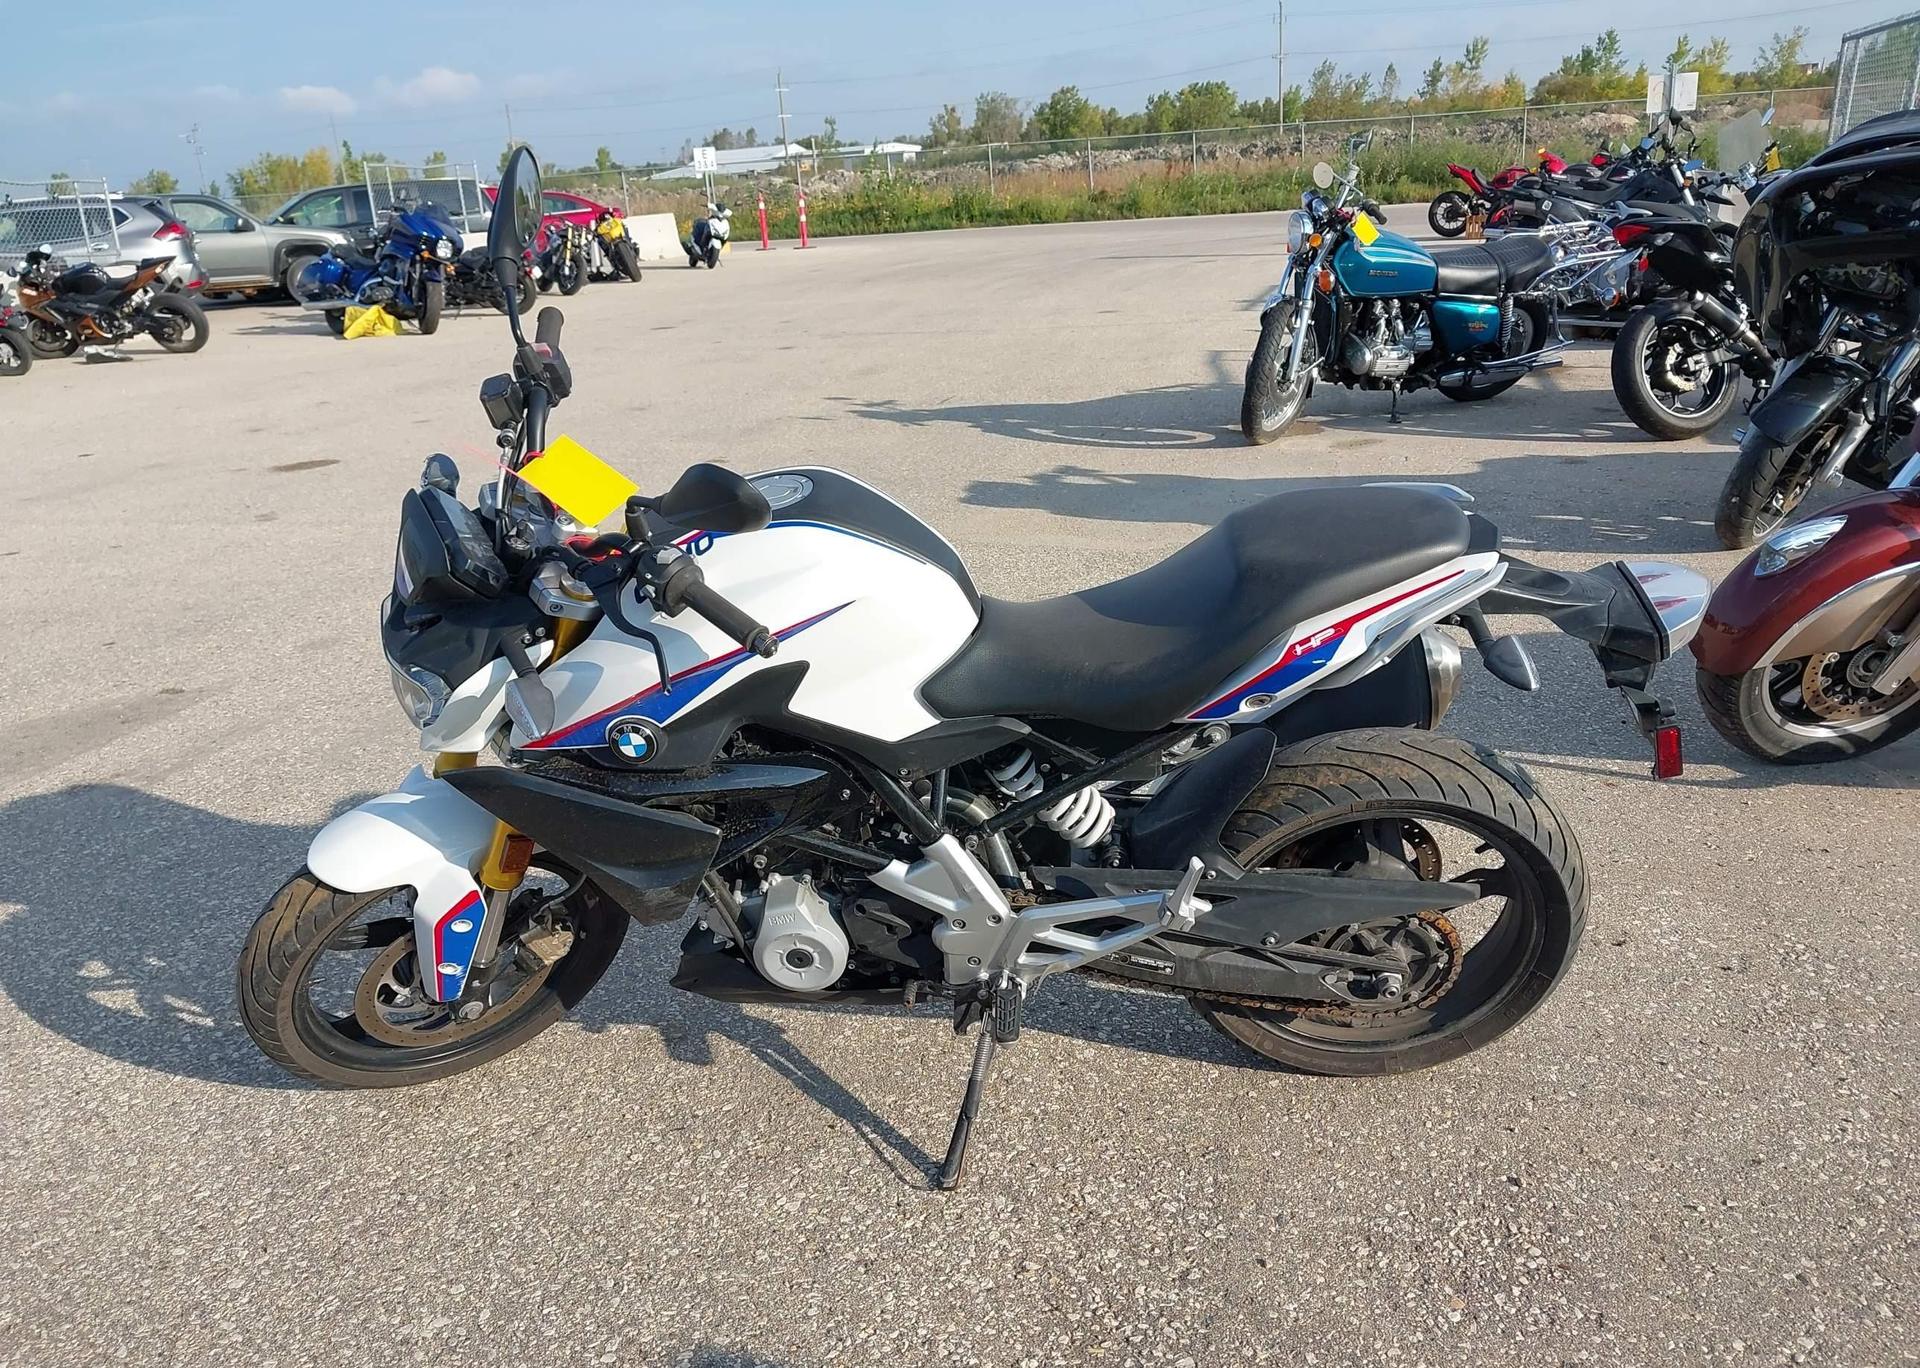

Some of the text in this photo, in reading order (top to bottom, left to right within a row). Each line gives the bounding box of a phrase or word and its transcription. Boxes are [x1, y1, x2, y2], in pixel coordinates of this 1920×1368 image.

[1295, 627, 1336, 656] HP
[612, 725, 649, 740] BMW
[768, 912, 796, 926] BMW
